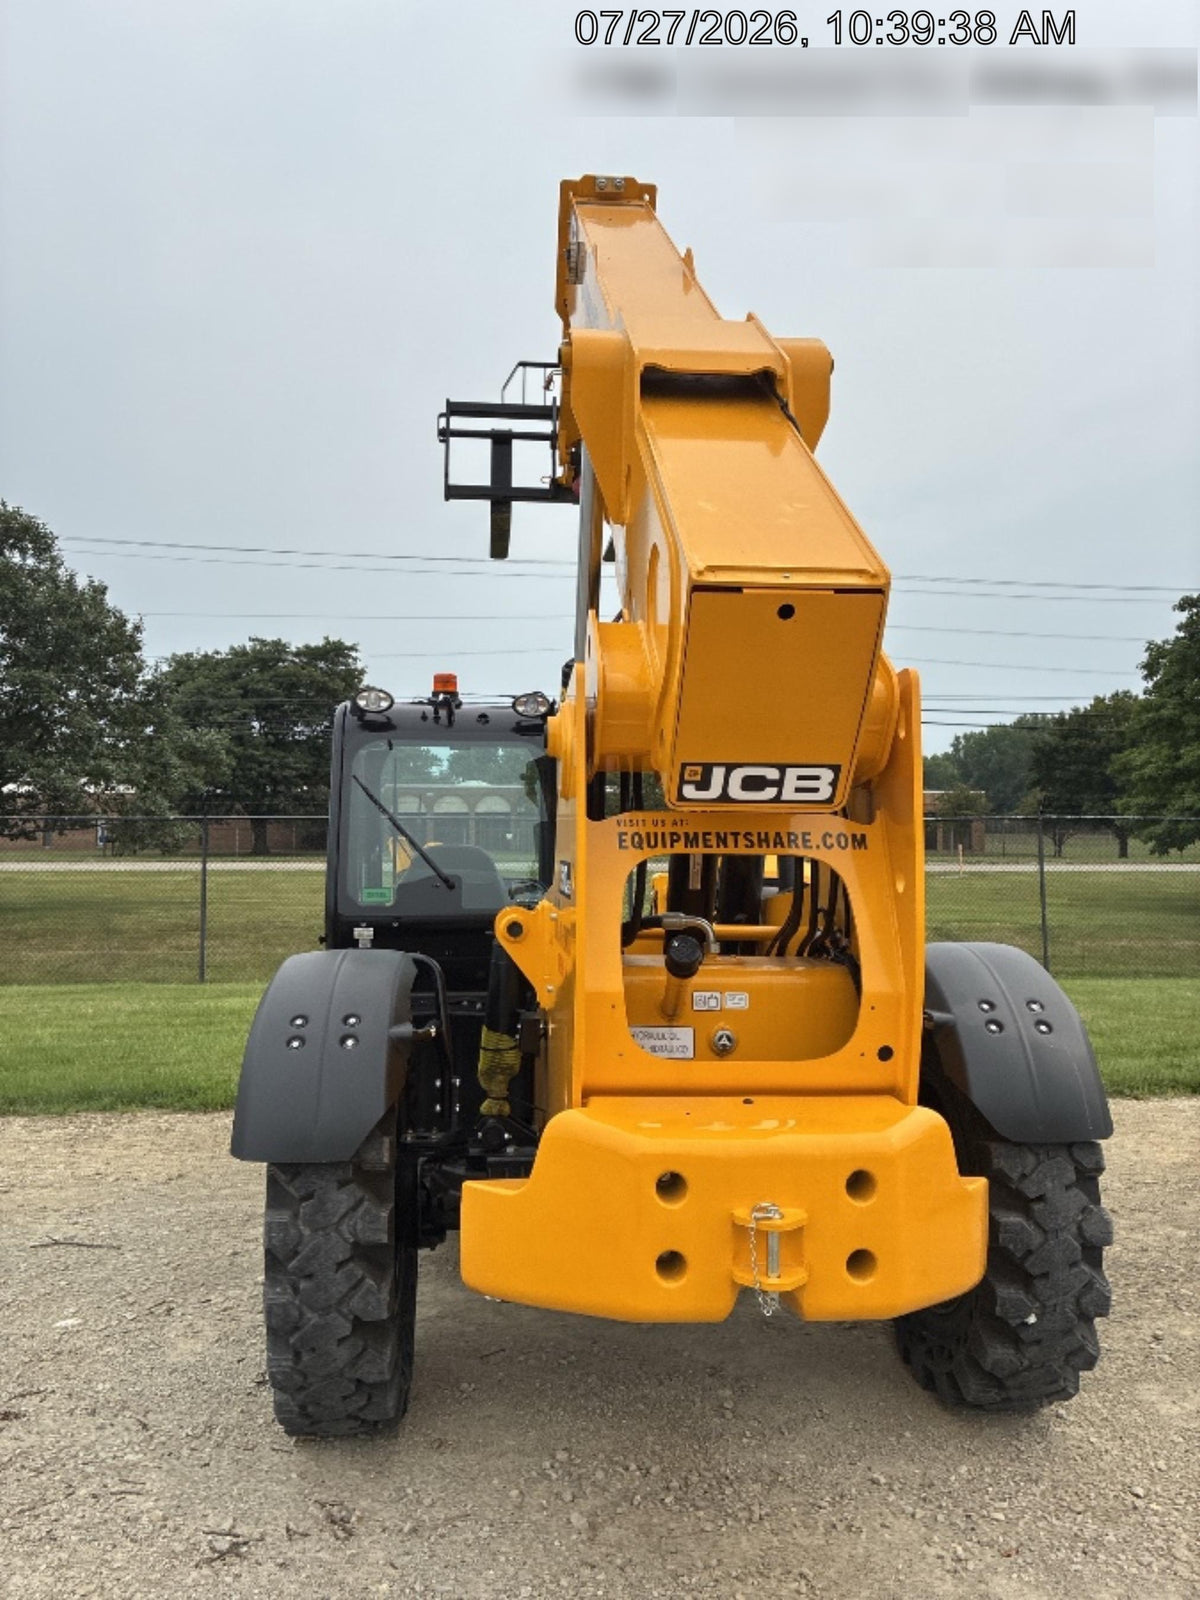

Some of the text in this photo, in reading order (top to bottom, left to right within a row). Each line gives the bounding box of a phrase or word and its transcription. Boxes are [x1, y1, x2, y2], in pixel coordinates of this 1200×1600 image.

[682, 766, 835, 801] JCB
[616, 819, 646, 828] VISIT
[651, 818, 667, 828] US
[617, 831, 868, 850] EQUIPMENTSHARE.COM
